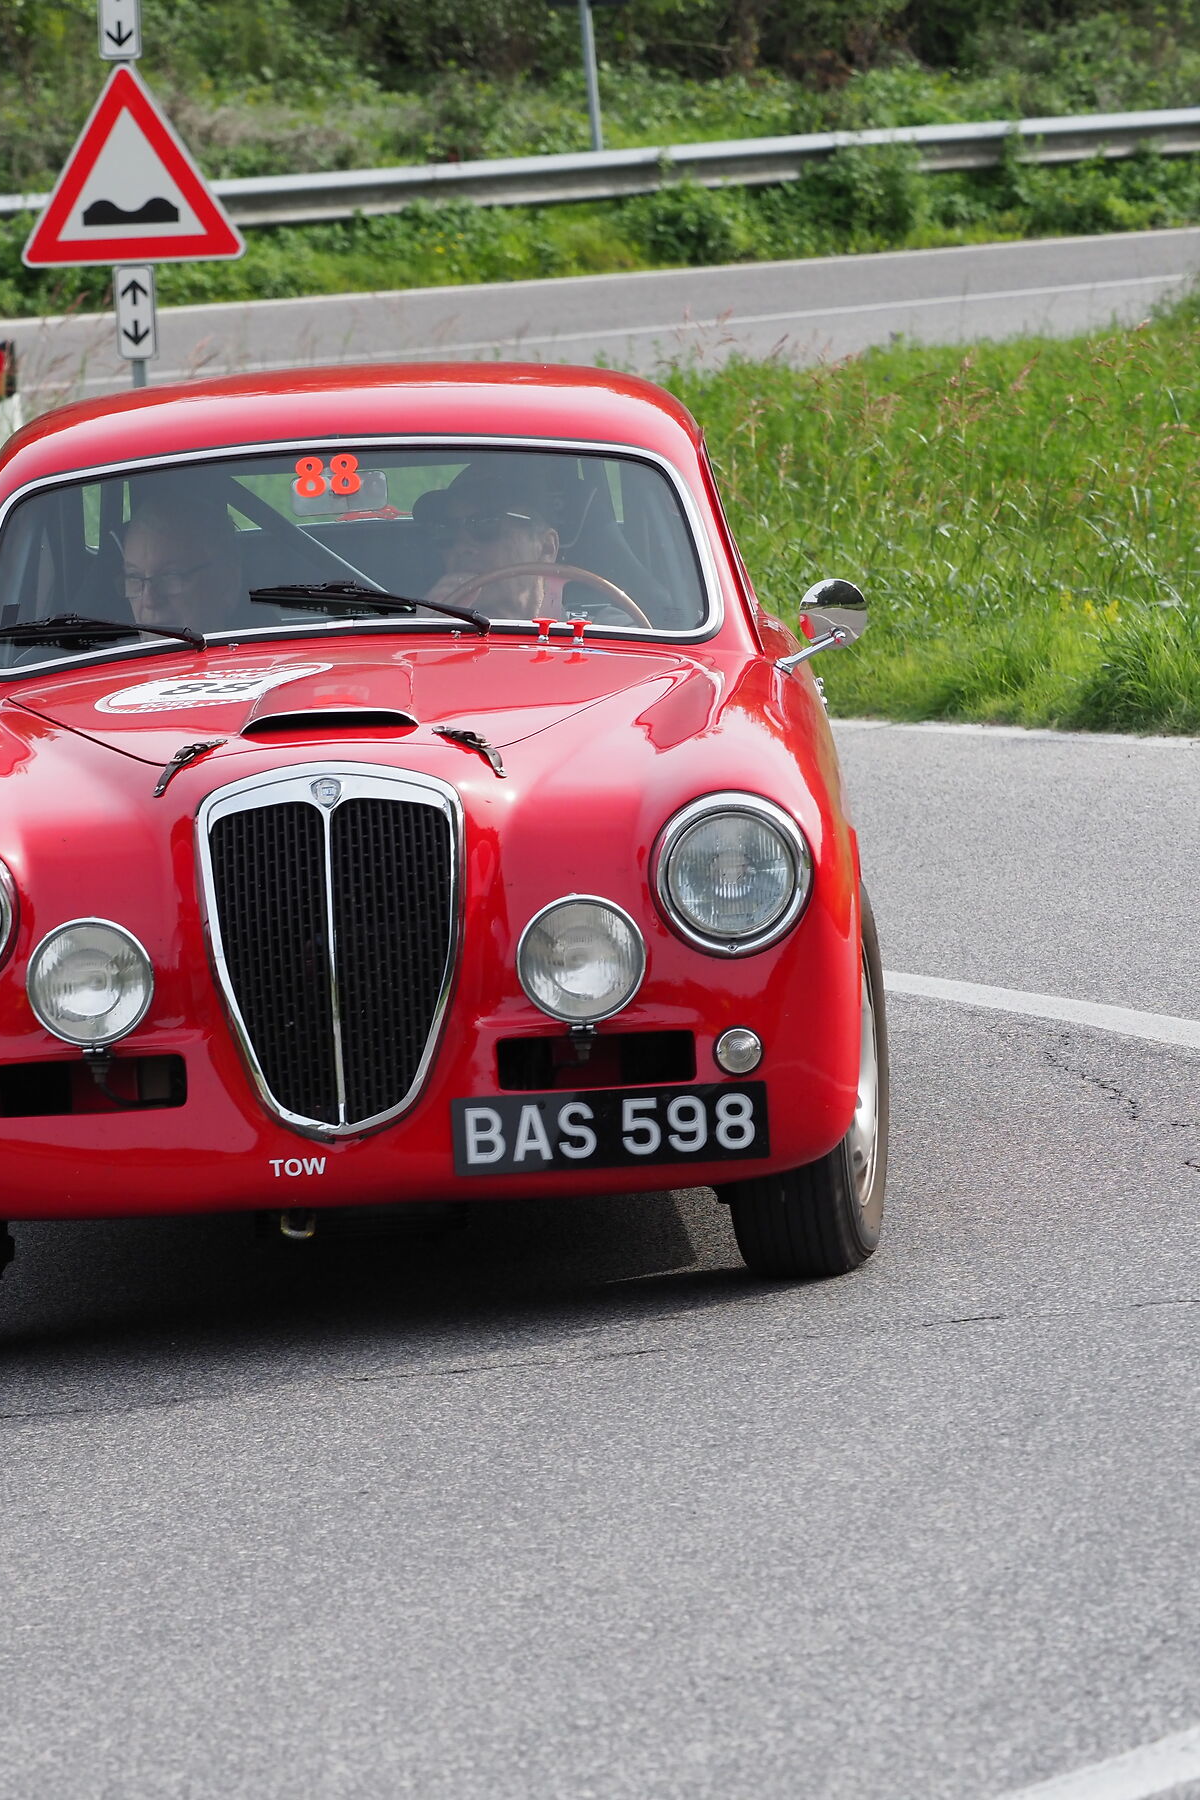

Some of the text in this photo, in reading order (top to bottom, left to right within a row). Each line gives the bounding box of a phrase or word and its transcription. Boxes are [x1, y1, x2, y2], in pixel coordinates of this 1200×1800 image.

[295, 453, 361, 498] 88
[158, 679, 263, 696] 88
[464, 1092, 756, 1165] BAS 598
[268, 1156, 326, 1177] TOW
